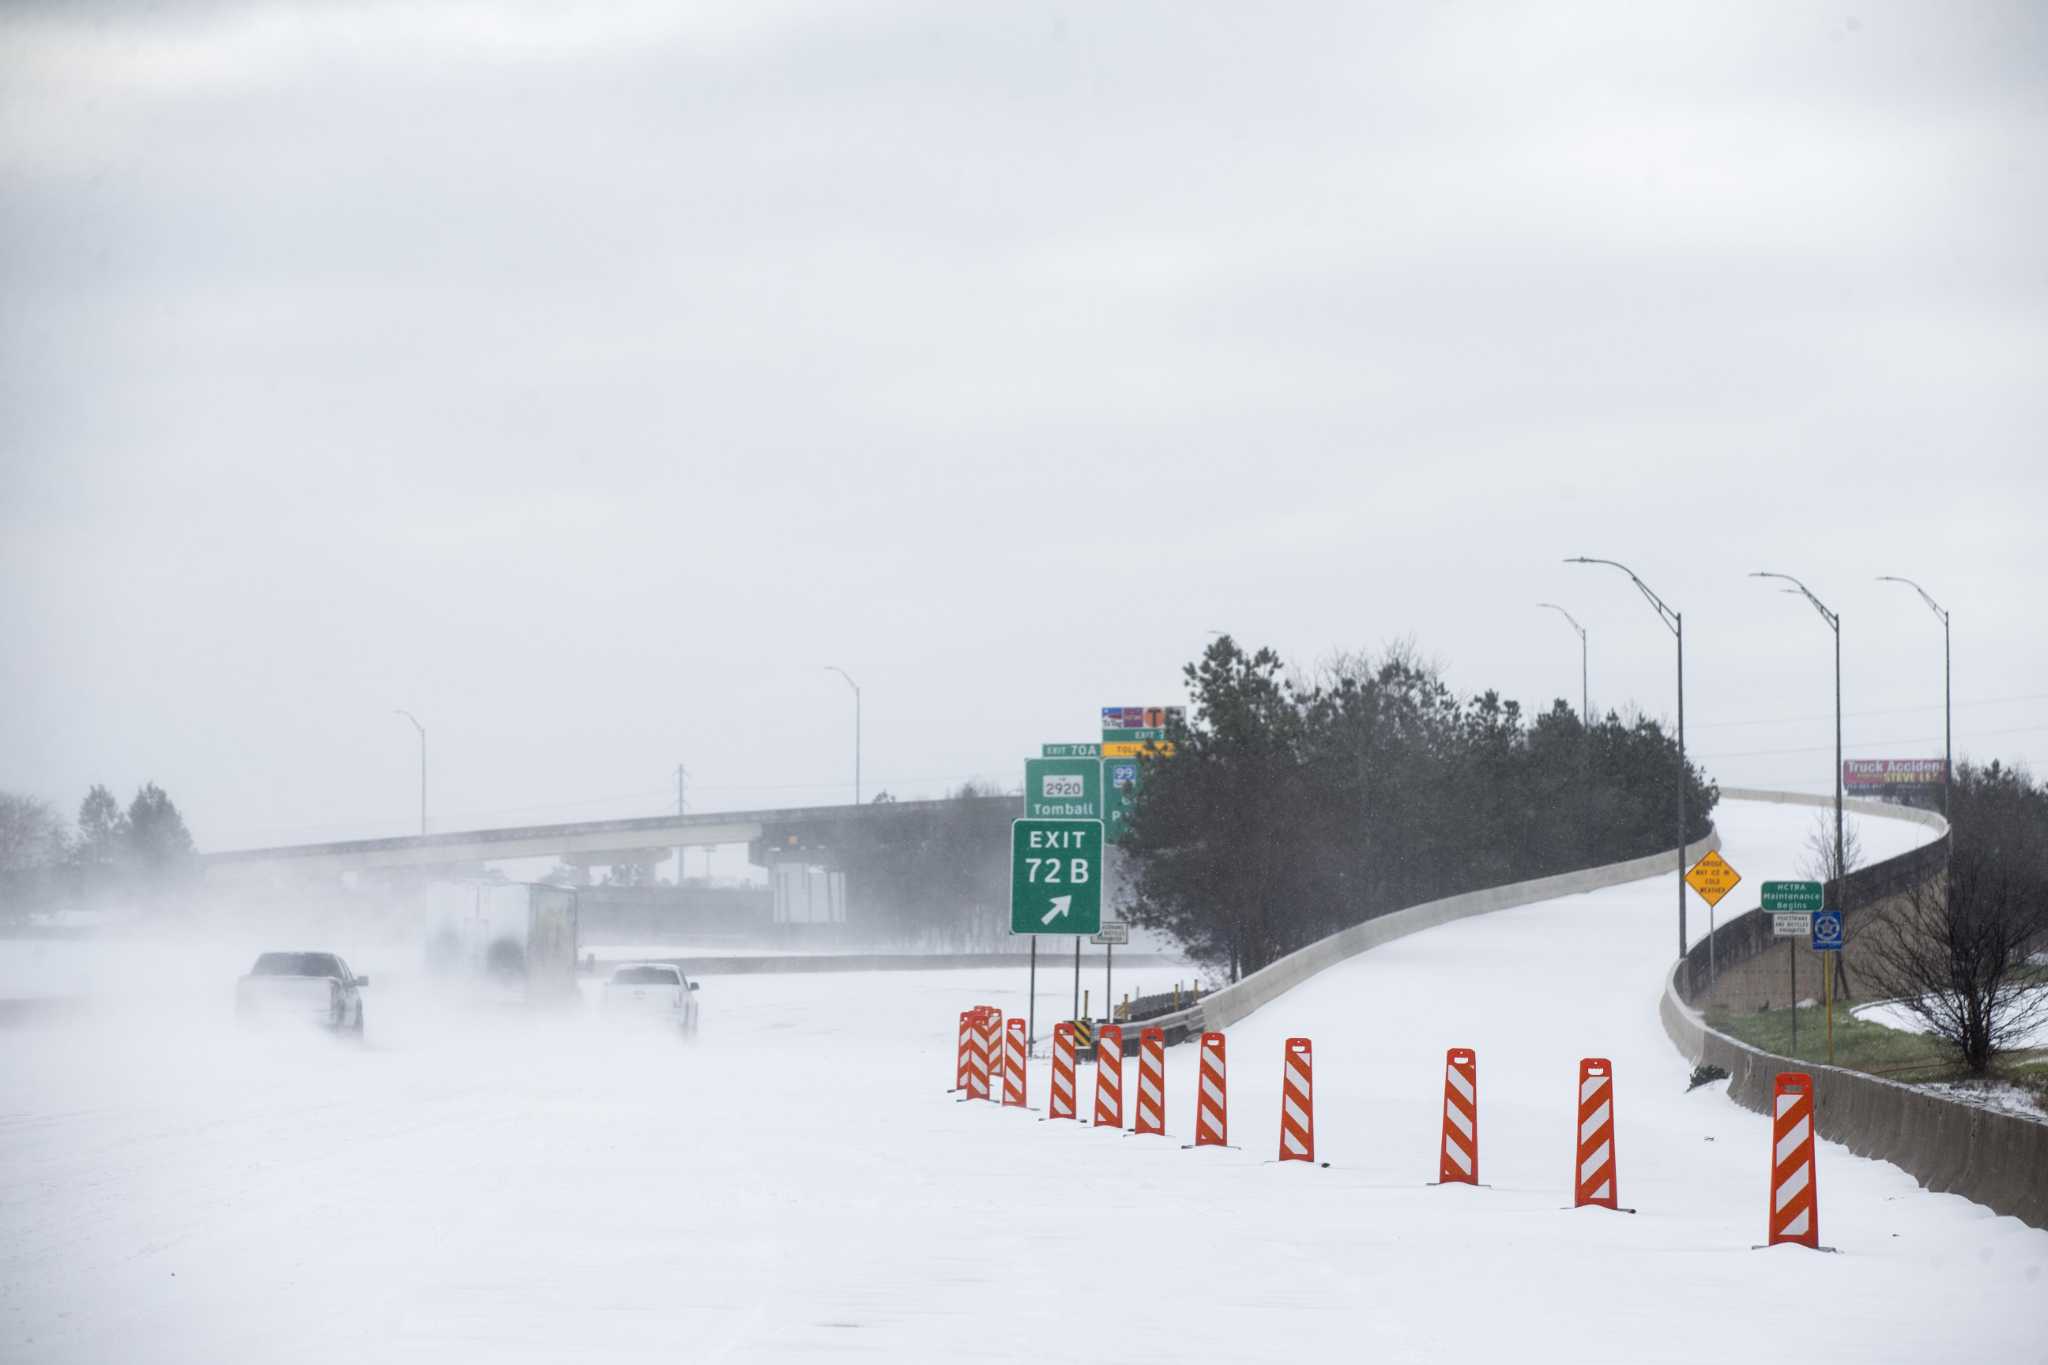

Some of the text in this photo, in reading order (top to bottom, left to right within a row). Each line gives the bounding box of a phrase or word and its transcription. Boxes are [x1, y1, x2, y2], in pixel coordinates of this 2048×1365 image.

[1046, 745, 1097, 756] EXIT 70A
[1848, 761, 1883, 772] Truck
[1115, 767, 1131, 778] 99
[1045, 783, 1081, 795] 2920
[1033, 803, 1094, 815] Tomball
[1030, 831, 1086, 848] EXIT
[1025, 858, 1089, 884] 72 B
[1763, 892, 1820, 900] Maintenance
[1776, 902, 1807, 910] Begins
